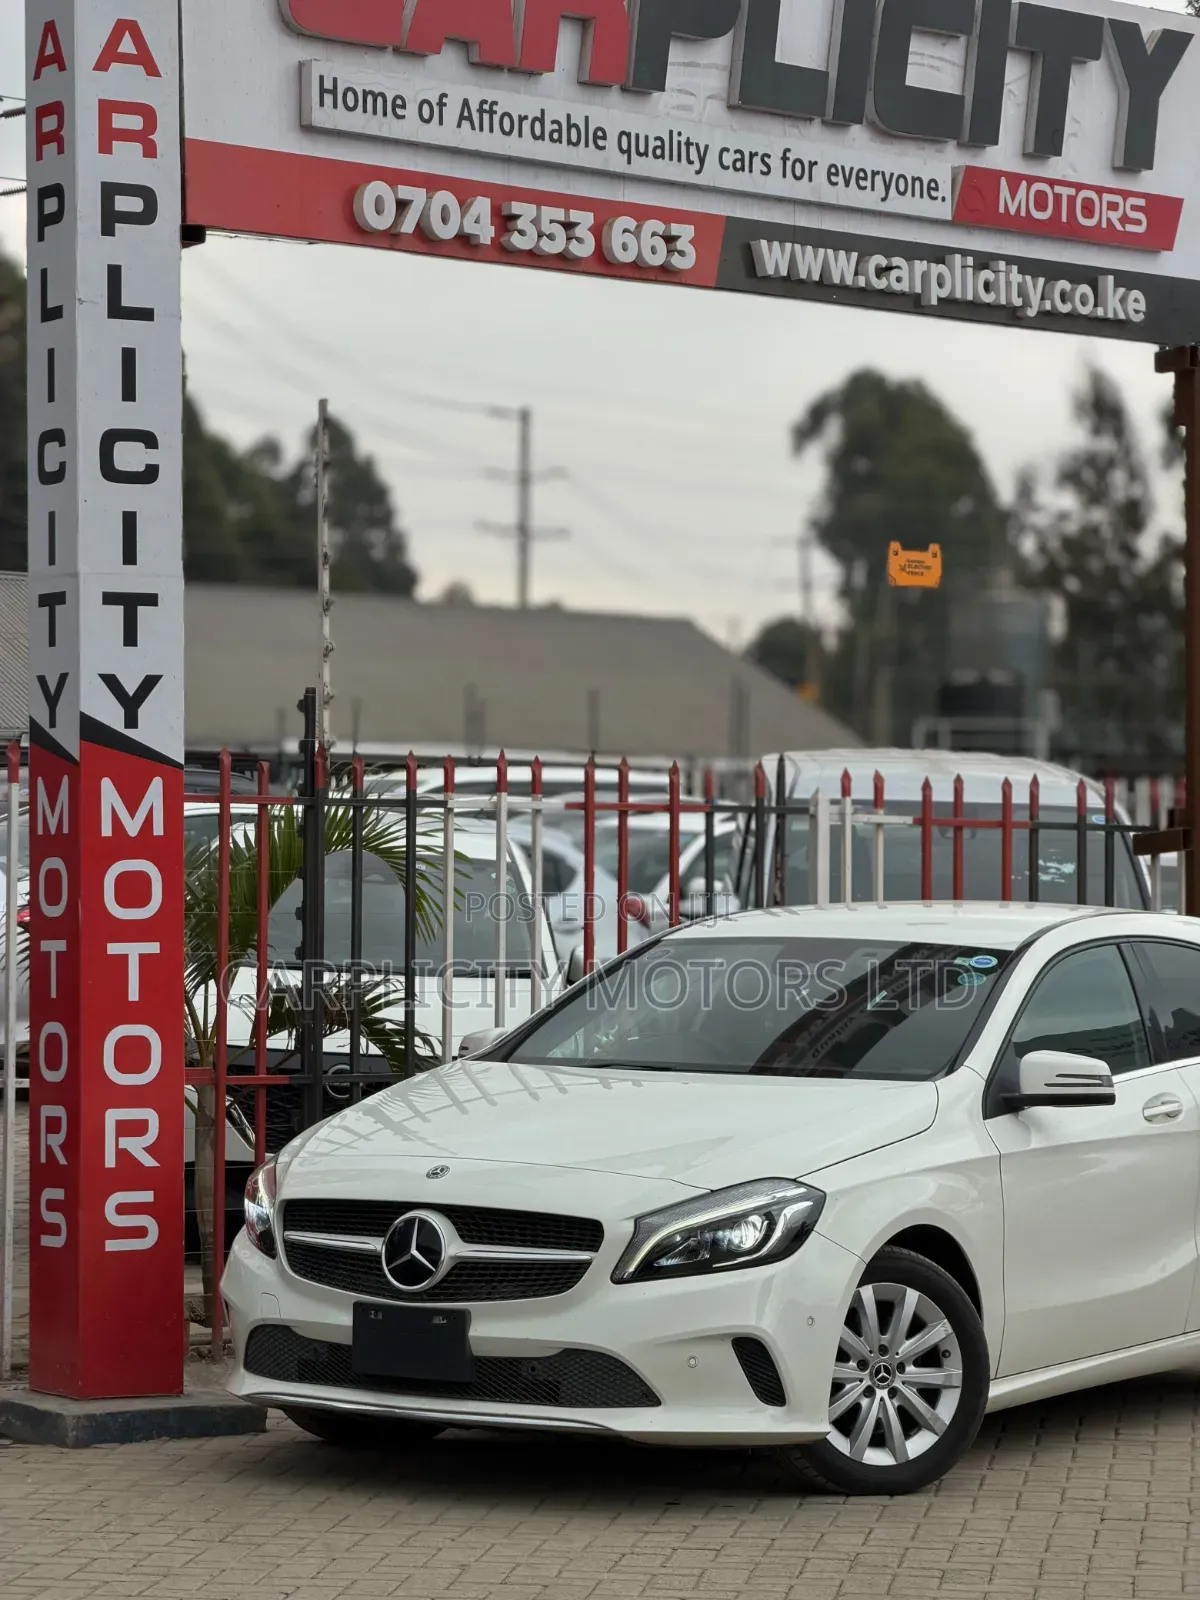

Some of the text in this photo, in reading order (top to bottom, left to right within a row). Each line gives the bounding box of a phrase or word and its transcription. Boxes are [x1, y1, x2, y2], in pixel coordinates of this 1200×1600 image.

[280, 0, 1194, 171] PLICITY
[318, 74, 947, 203] Home of Affordable quality cars for everyone.
[354, 180, 696, 272] 0704 353 663
[998, 176, 1148, 234] MOTORS
[750, 239, 1146, 323] www.carplicity.co.ke
[36, 774, 69, 1248] MOTORS
[101, 776, 164, 1252] MOTORS
